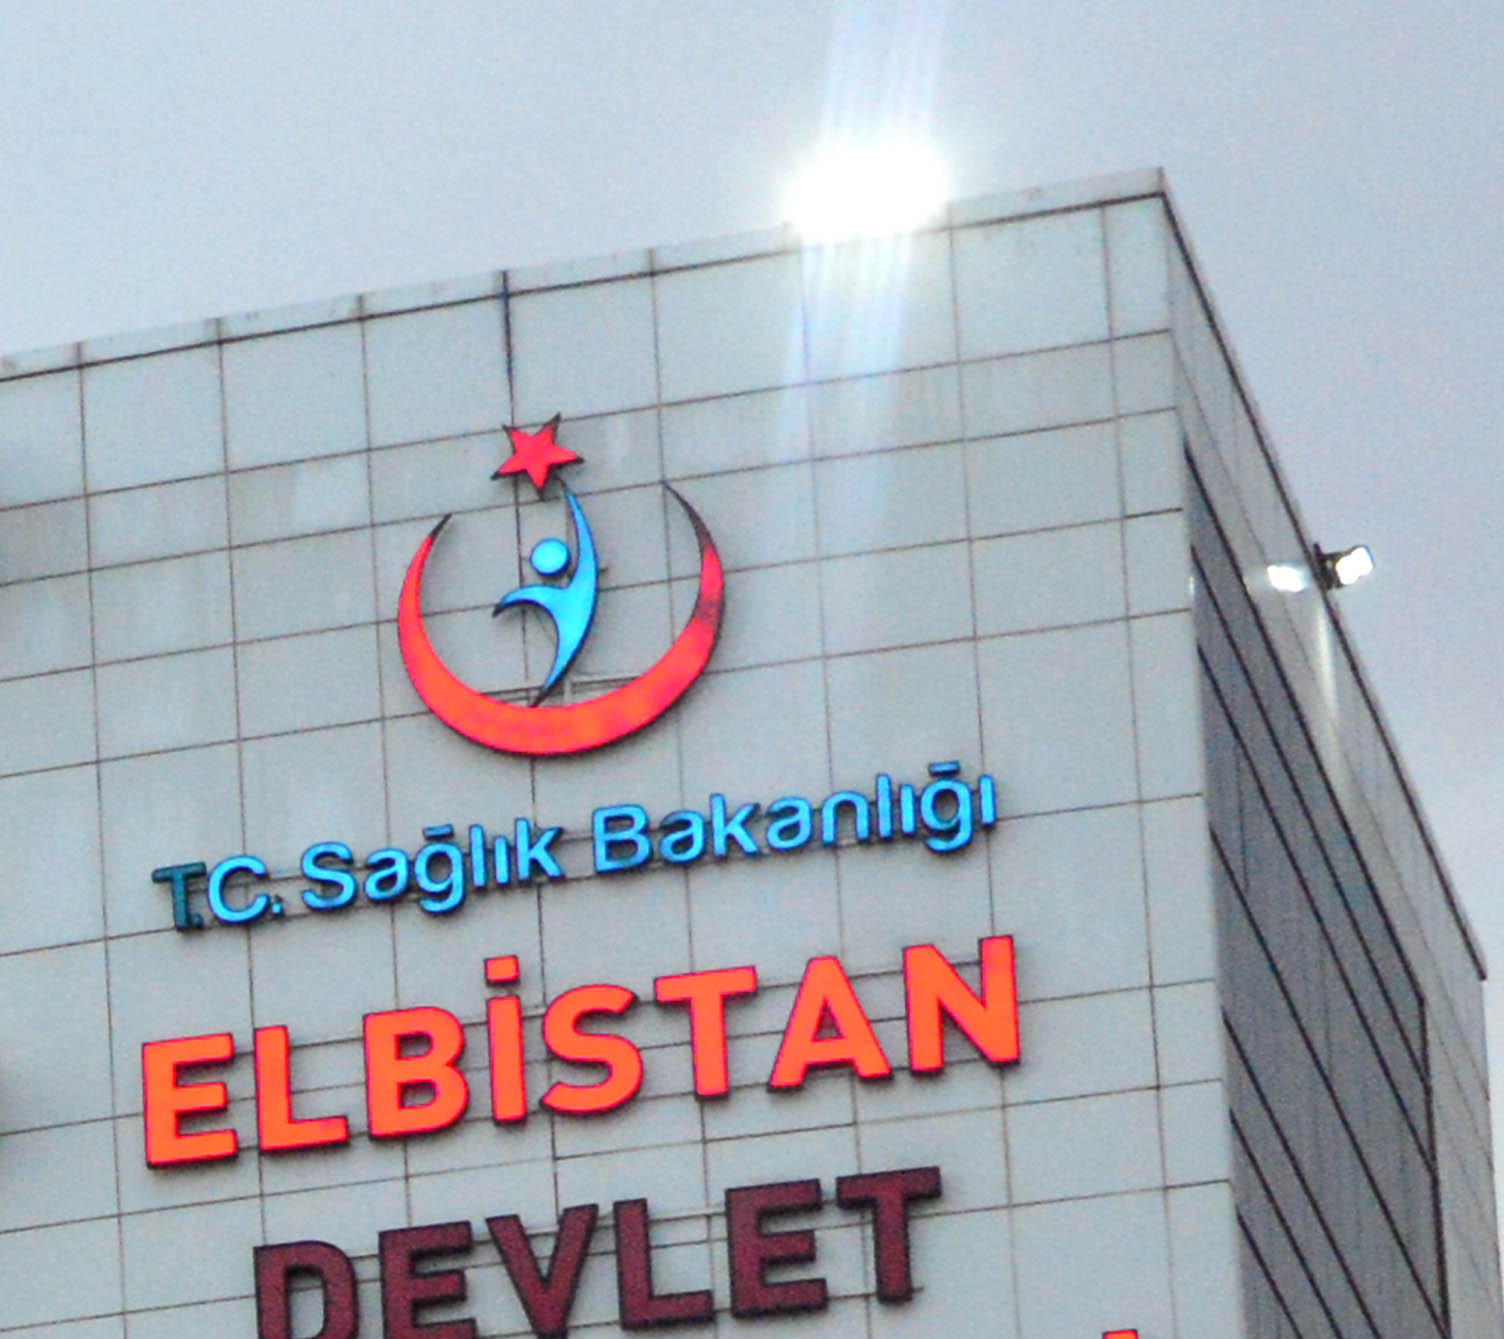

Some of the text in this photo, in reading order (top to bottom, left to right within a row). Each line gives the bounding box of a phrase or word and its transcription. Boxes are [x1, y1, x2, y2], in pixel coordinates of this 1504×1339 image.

[299, 817, 565, 917] Sağlık
[591, 760, 997, 876] Bakanlığı
[140, 934, 1024, 1172] ELBİSTAN
